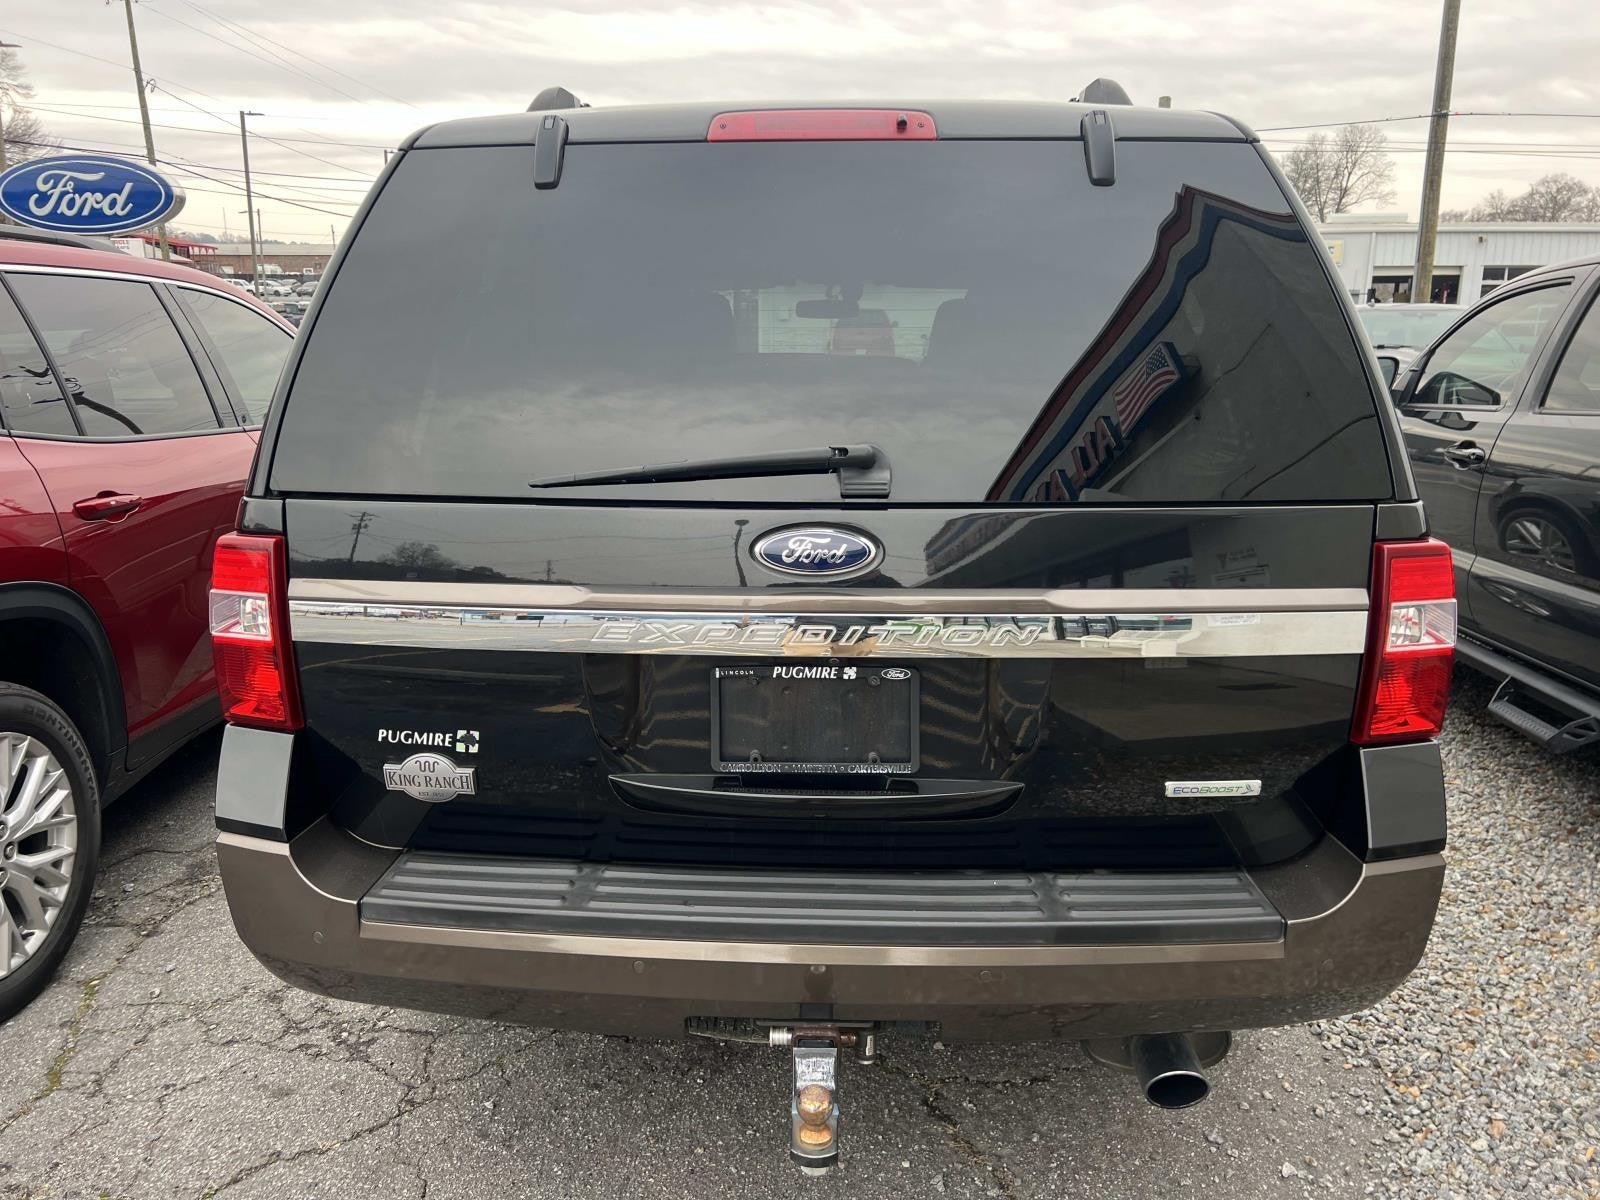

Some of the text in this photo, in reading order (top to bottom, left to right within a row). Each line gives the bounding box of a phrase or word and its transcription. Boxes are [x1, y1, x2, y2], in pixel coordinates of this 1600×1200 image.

[28, 168, 134, 217] Ford
[781, 536, 848, 564] Ford
[591, 621, 1044, 647] EXPEDITION
[772, 666, 839, 679] PUGMIRE
[377, 729, 453, 747] PUGMIRE
[847, 764, 911, 774] CARTERSVILLE
[387, 771, 470, 790] KING RANCH
